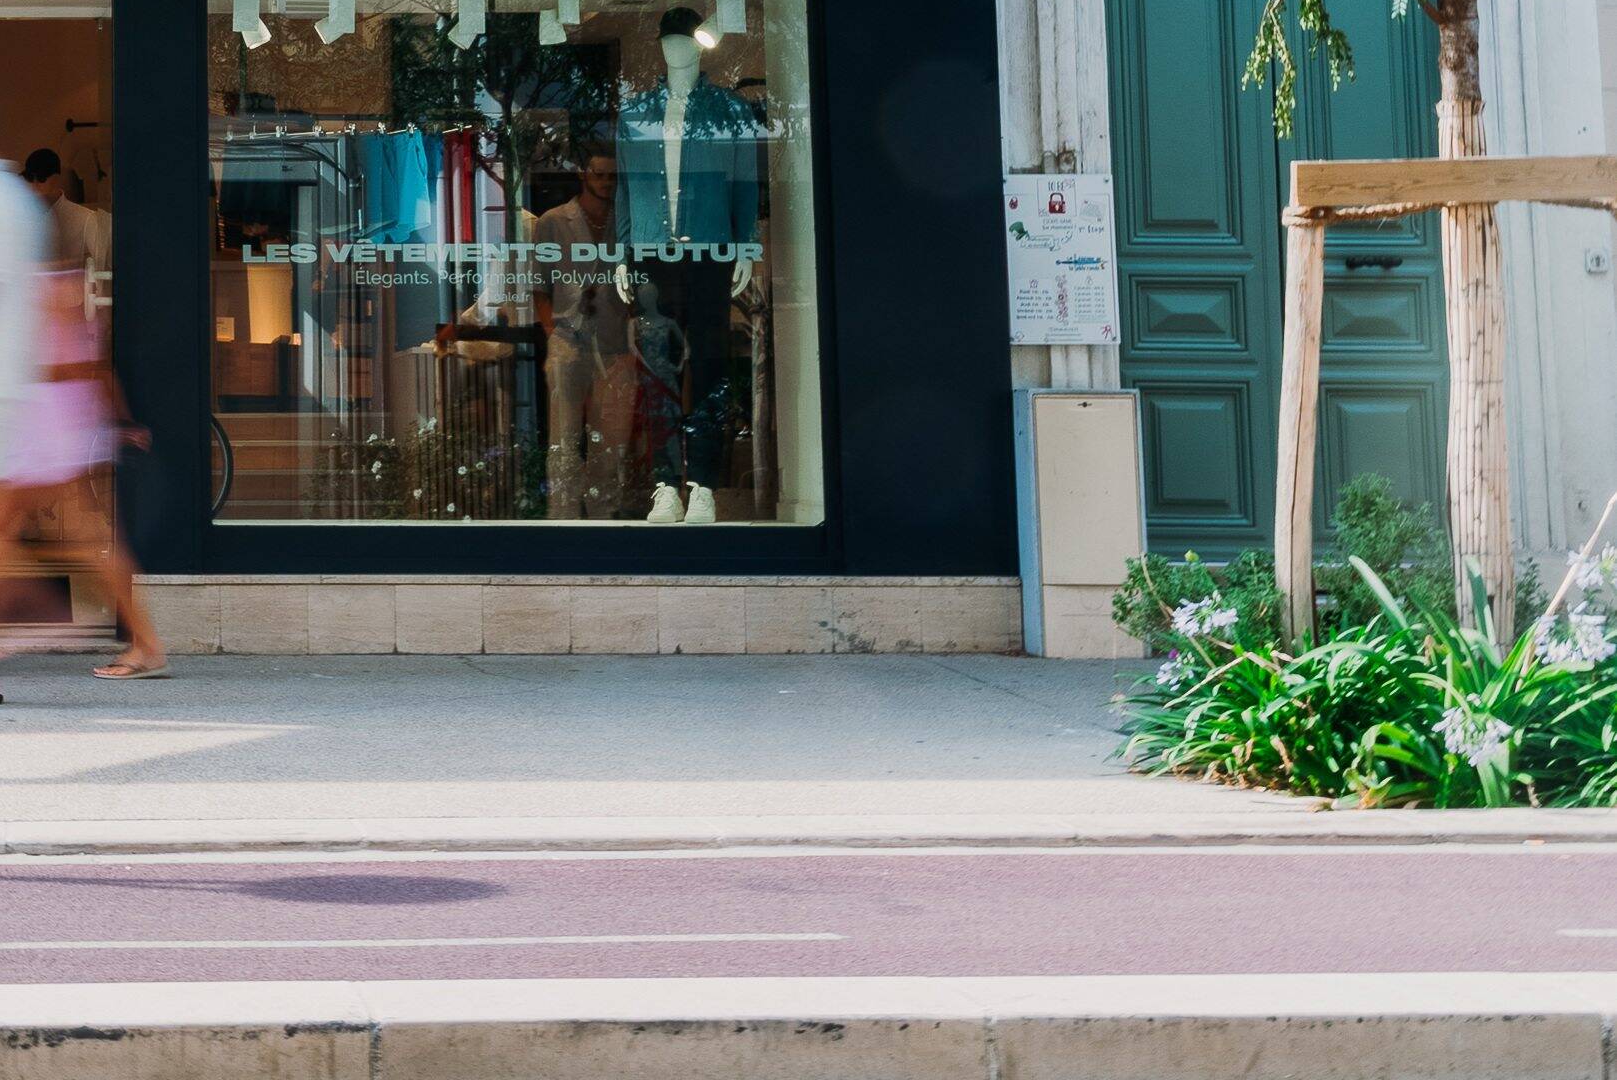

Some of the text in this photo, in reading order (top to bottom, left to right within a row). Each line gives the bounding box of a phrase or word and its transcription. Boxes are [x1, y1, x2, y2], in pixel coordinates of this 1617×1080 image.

[242, 239, 763, 263] LES VÊTEMENTS DU FUTUR
[551, 269, 649, 287] Polyvalents
